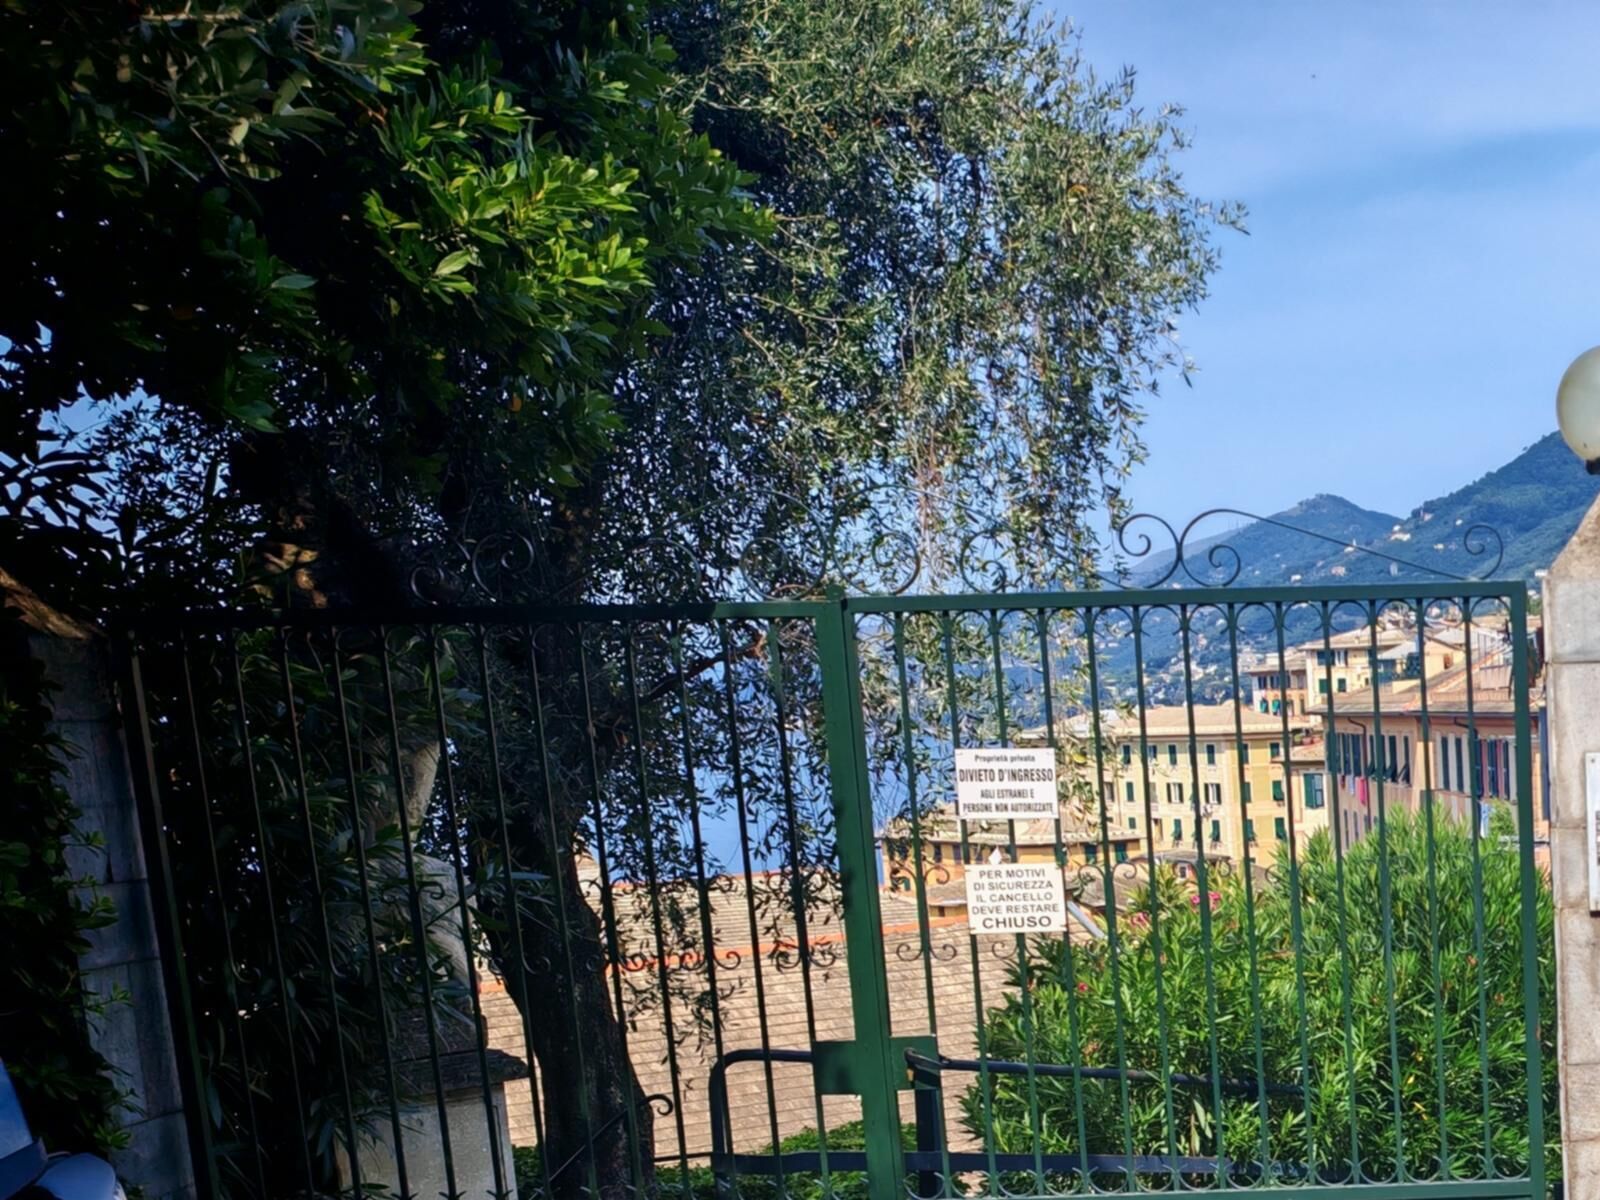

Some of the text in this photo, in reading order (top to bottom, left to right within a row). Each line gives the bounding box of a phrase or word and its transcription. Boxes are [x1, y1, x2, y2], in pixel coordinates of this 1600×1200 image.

[1010, 755, 1035, 763] privata
[959, 768, 1053, 782] DIVIETO D'INGRESSO
[980, 788, 1034, 798] AGLI ESTRANEI E
[963, 802, 1053, 812] PERSONE NON AUTORIZZATE
[979, 868, 1045, 879] PER MOTIVI
[973, 880, 1053, 891] DI SICUREZZA
[976, 892, 1053, 903] IL CANCELLO
[972, 903, 1059, 915] DEVE RESTARE
[982, 915, 1052, 929] CHIUSO
